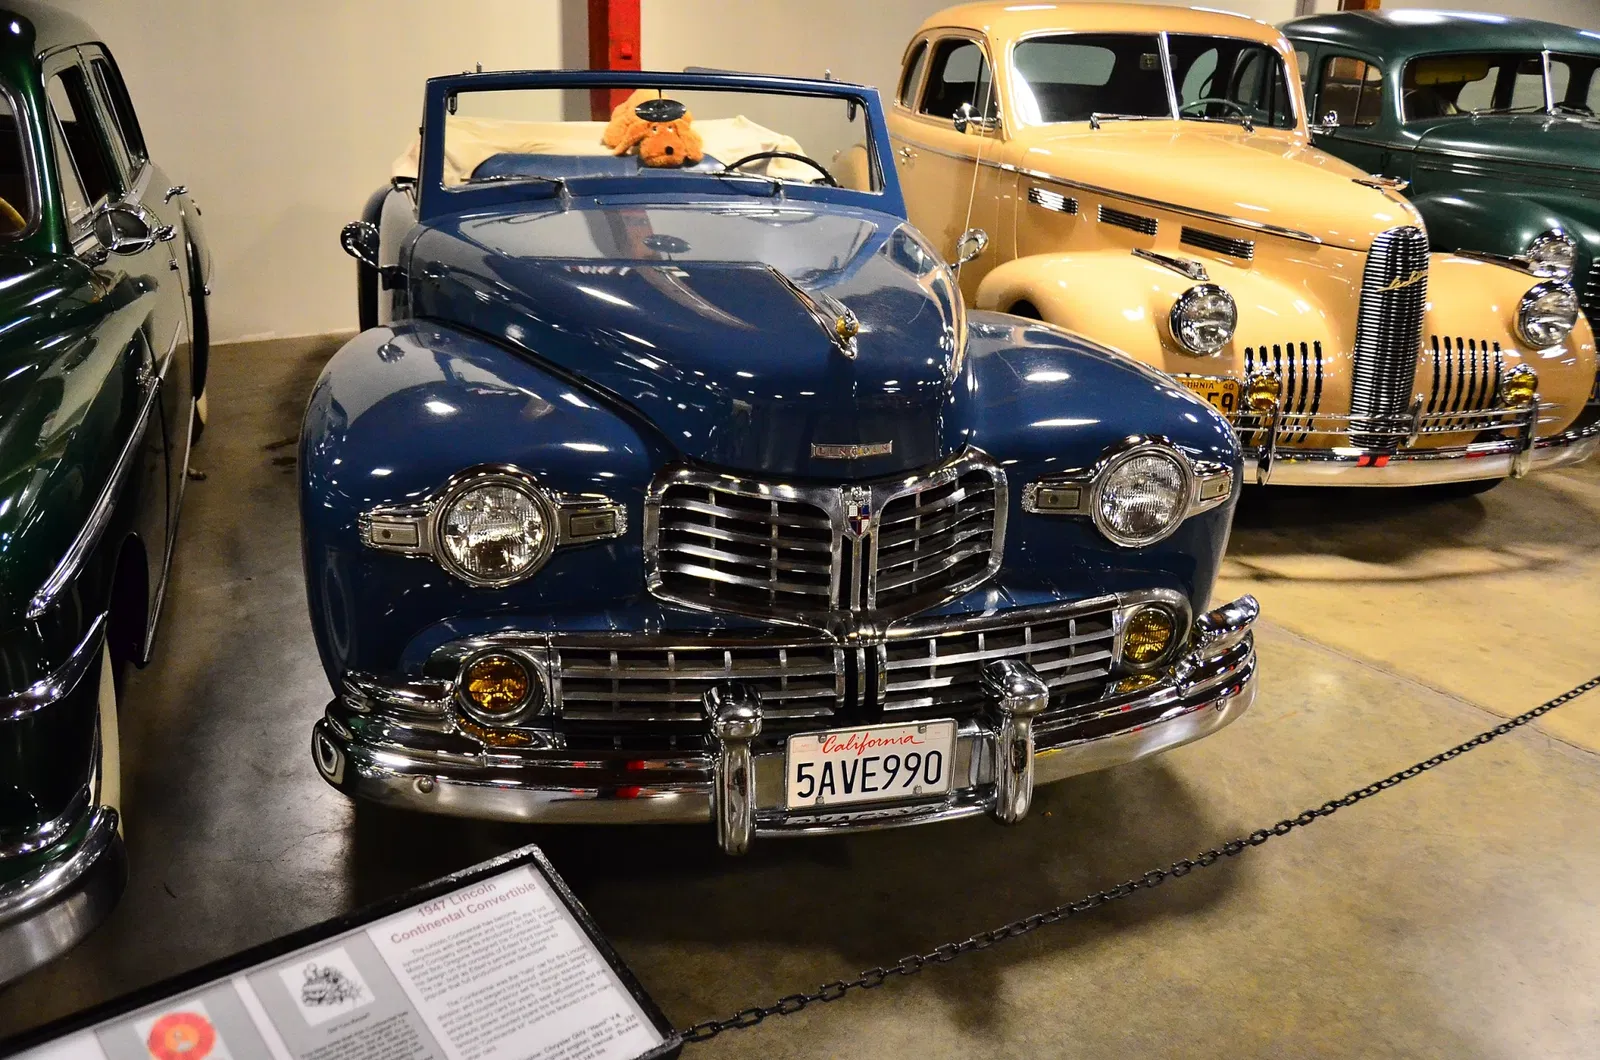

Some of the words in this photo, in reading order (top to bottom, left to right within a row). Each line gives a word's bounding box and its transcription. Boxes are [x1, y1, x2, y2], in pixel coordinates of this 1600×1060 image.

[822, 731, 925, 756] California
[797, 750, 943, 798] 5AVE990
[390, 908, 466, 945] Continental
[466, 881, 537, 915] Convertible
[417, 899, 447, 918] 1947
[451, 881, 497, 907] Lincoln
